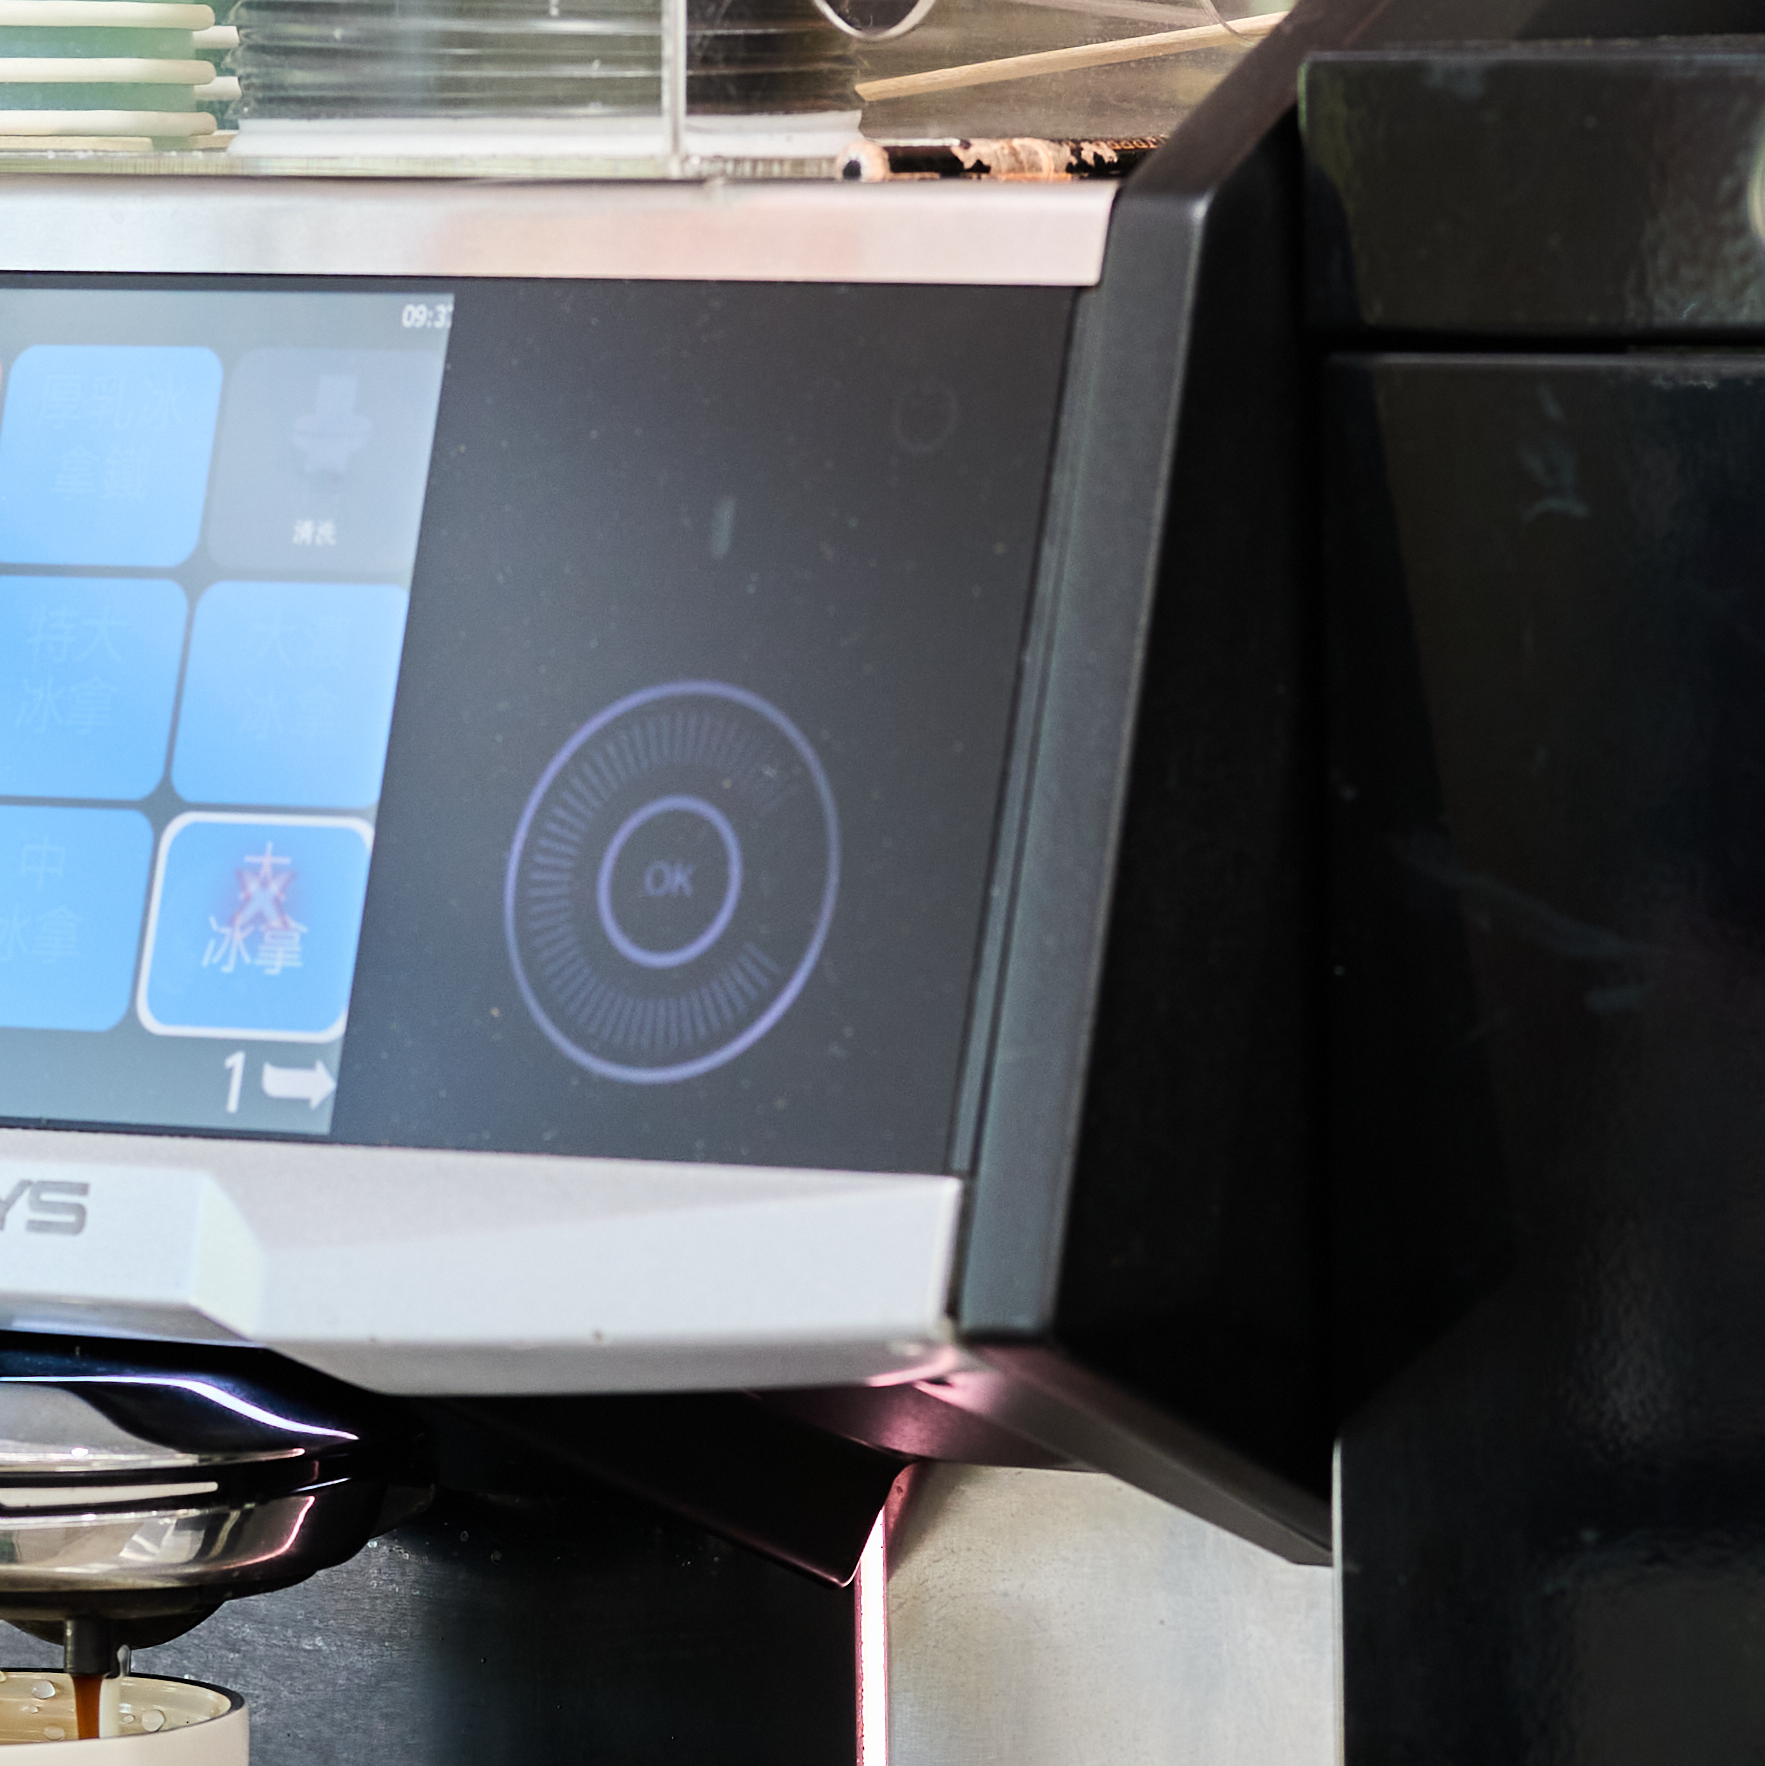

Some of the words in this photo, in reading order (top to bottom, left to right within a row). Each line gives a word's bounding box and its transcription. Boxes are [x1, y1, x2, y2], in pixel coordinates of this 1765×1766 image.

[27, 604, 128, 665] 特大
[19, 833, 67, 893] 中
[645, 861, 694, 897] OK
[224, 1051, 246, 1114] 1
